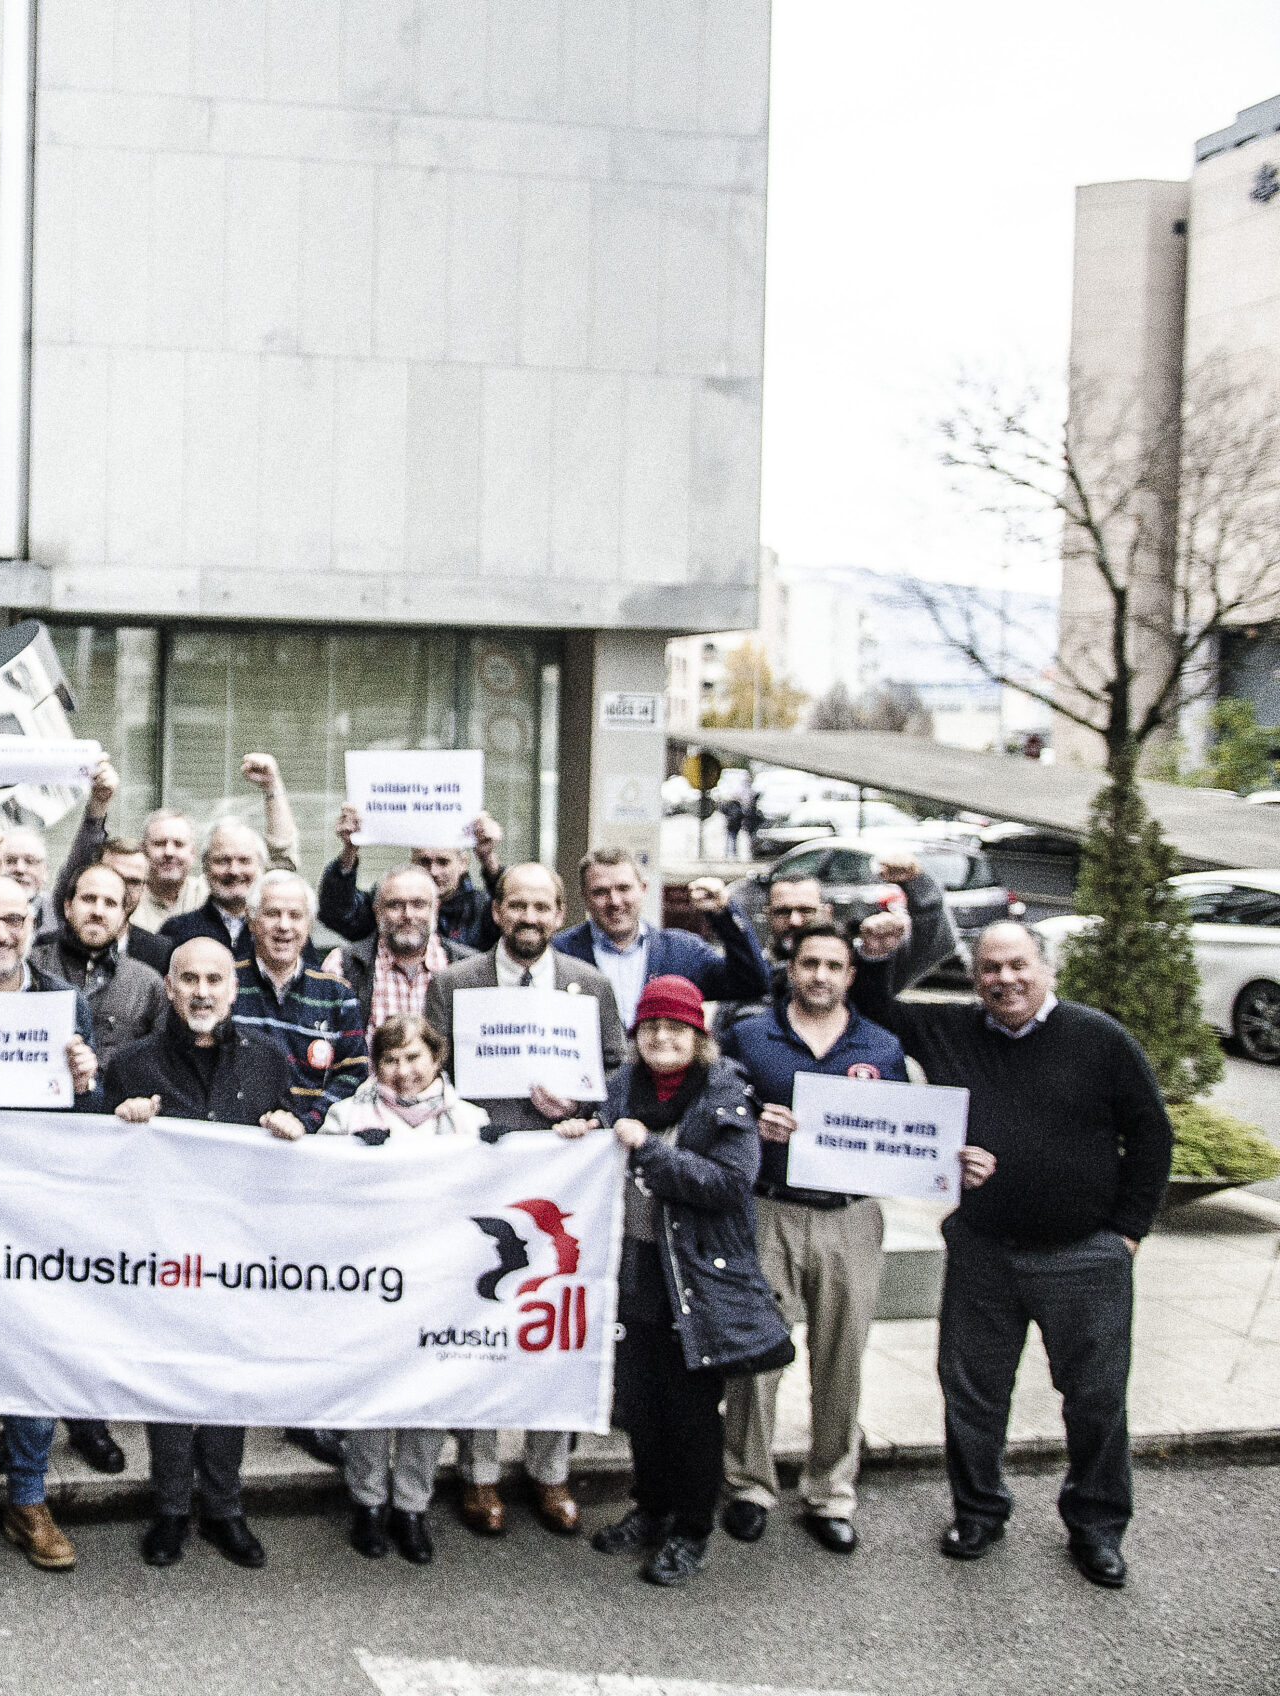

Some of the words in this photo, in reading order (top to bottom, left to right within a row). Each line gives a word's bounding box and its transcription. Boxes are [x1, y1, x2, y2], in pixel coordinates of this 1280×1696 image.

[15, 1027, 50, 1043] with
[480, 1022, 546, 1038] Solidarity
[551, 1025, 577, 1039] with
[823, 1112, 898, 1135] Solidarity
[902, 1121, 938, 1138] with
